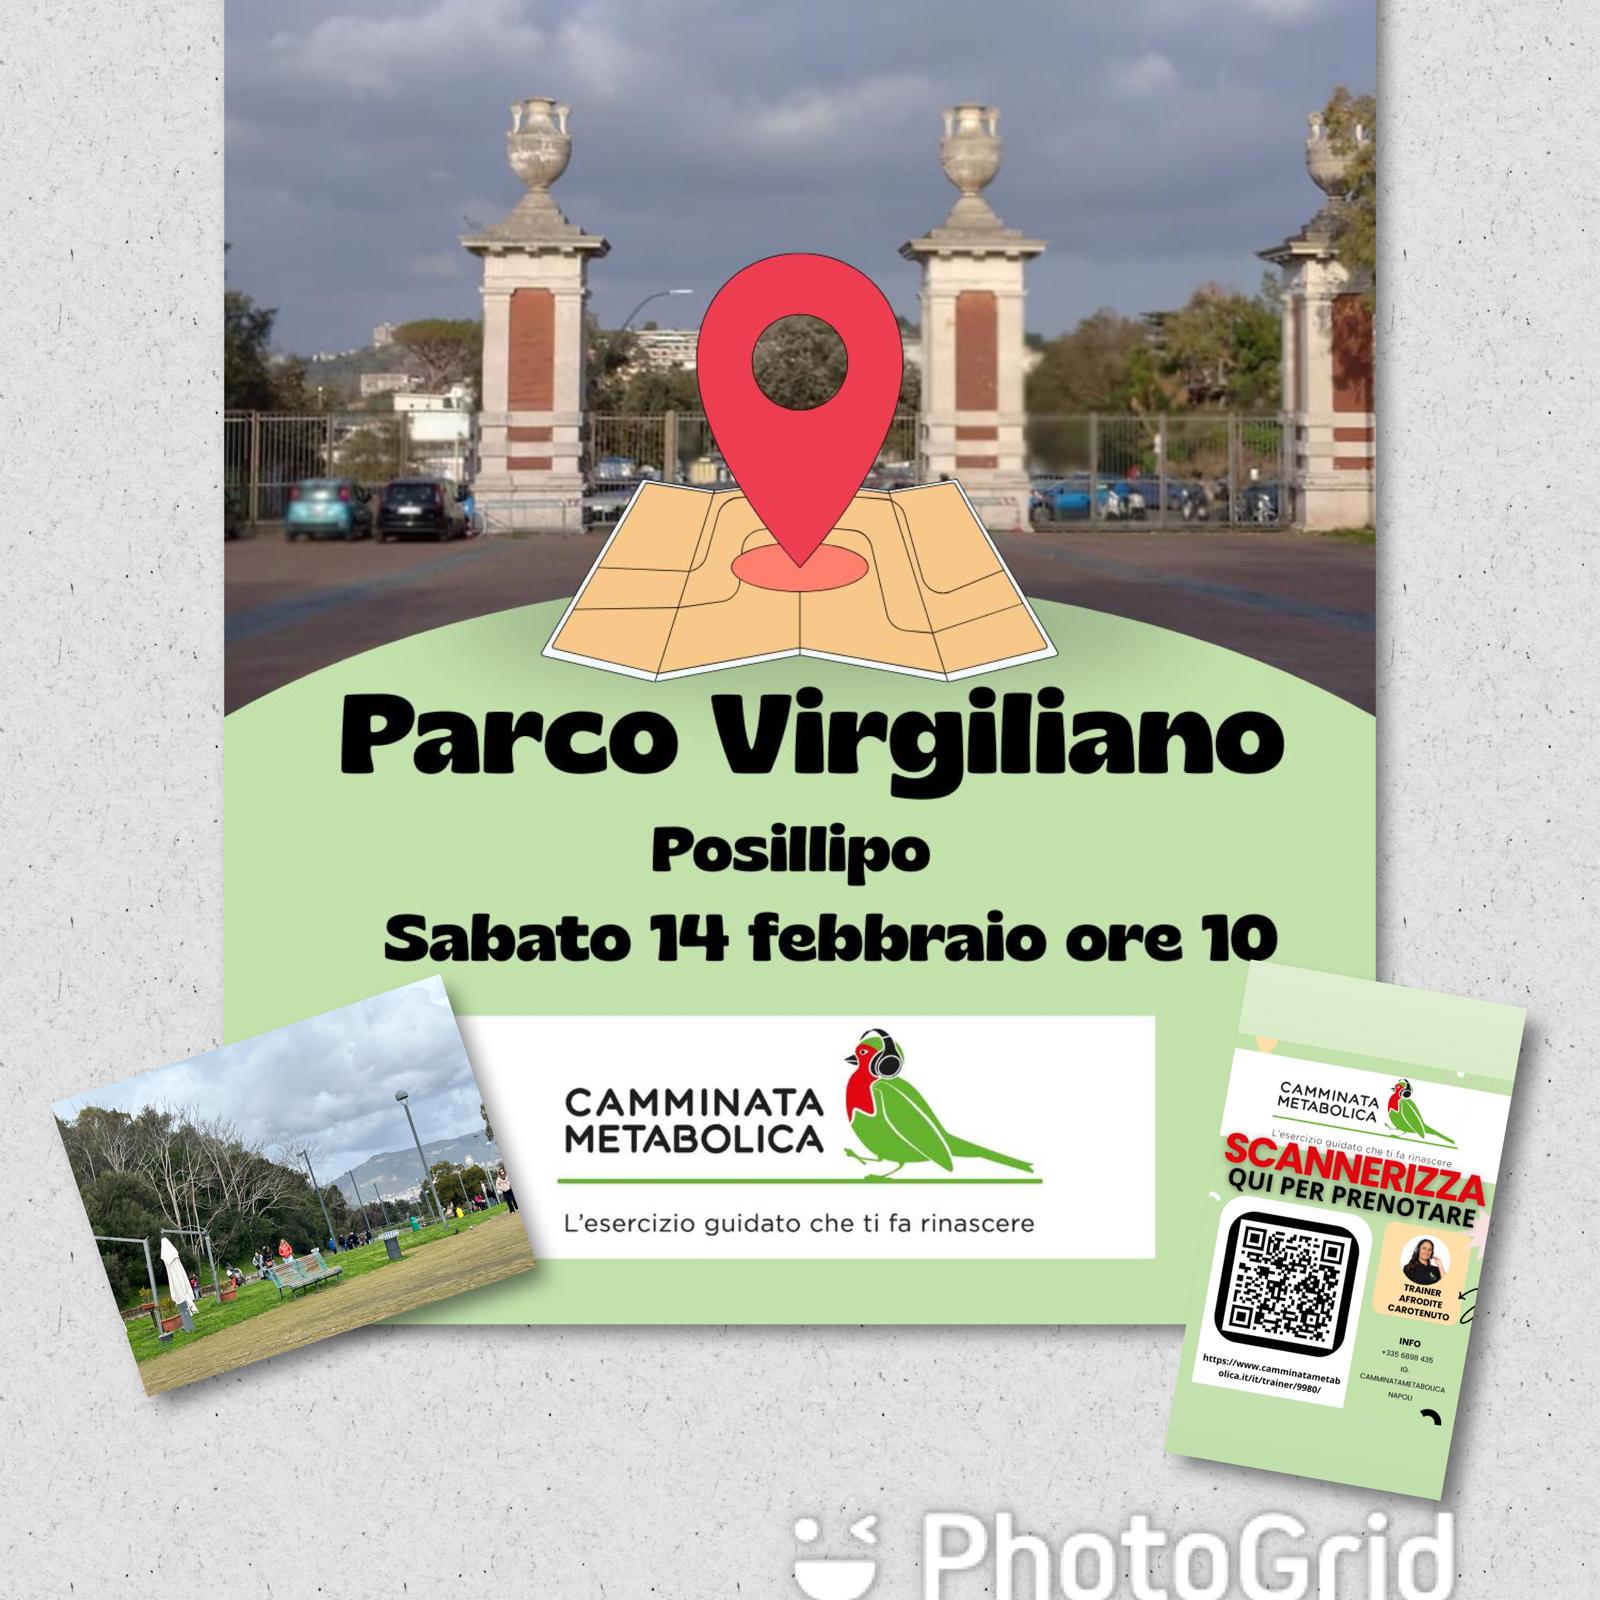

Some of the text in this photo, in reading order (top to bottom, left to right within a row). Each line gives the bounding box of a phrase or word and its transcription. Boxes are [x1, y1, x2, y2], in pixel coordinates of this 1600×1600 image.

[341, 687, 1285, 799] Parco Virgiliano
[652, 823, 930, 886] Posillipo
[385, 910, 1277, 963] Sabato 14 febbraio ore 10
[565, 1087, 824, 1117] CAMMINATA
[1277, 1095, 1377, 1123] METABOLICA
[1280, 1081, 1379, 1109] CAMMINATA
[565, 1123, 824, 1154] METABOLICA
[1325, 1139, 1363, 1152] guidato
[1365, 1145, 1384, 1156] che
[1386, 1149, 1393, 1158] ti
[1395, 1150, 1405, 1160] fa
[1407, 1153, 1453, 1168] rinascere
[1224, 1132, 1486, 1206] SCANNERIZZA
[1228, 1168, 1476, 1228] QUI PER PRENOTARE
[565, 1212, 1035, 1237] L’esercizio guidato che ti fa rinascere
[1399, 1295, 1443, 1309] AFRODITE
[1403, 1284, 1441, 1297] TRAINER
[1387, 1304, 1450, 1321] CAROTENUTO
[1381, 1349, 1399, 1358] +335
[1420, 1355, 1434, 1364] 435
[1399, 1337, 1421, 1348] INFO
[1202, 1353, 1341, 1385] https://www.camminatametab
[1218, 1370, 1321, 1394] olica.it/it/trainer/9980/
[1359, 1372, 1446, 1393] CAMMINATAMETABOLICA
[1387, 1391, 1413, 1401] NAPOLI
